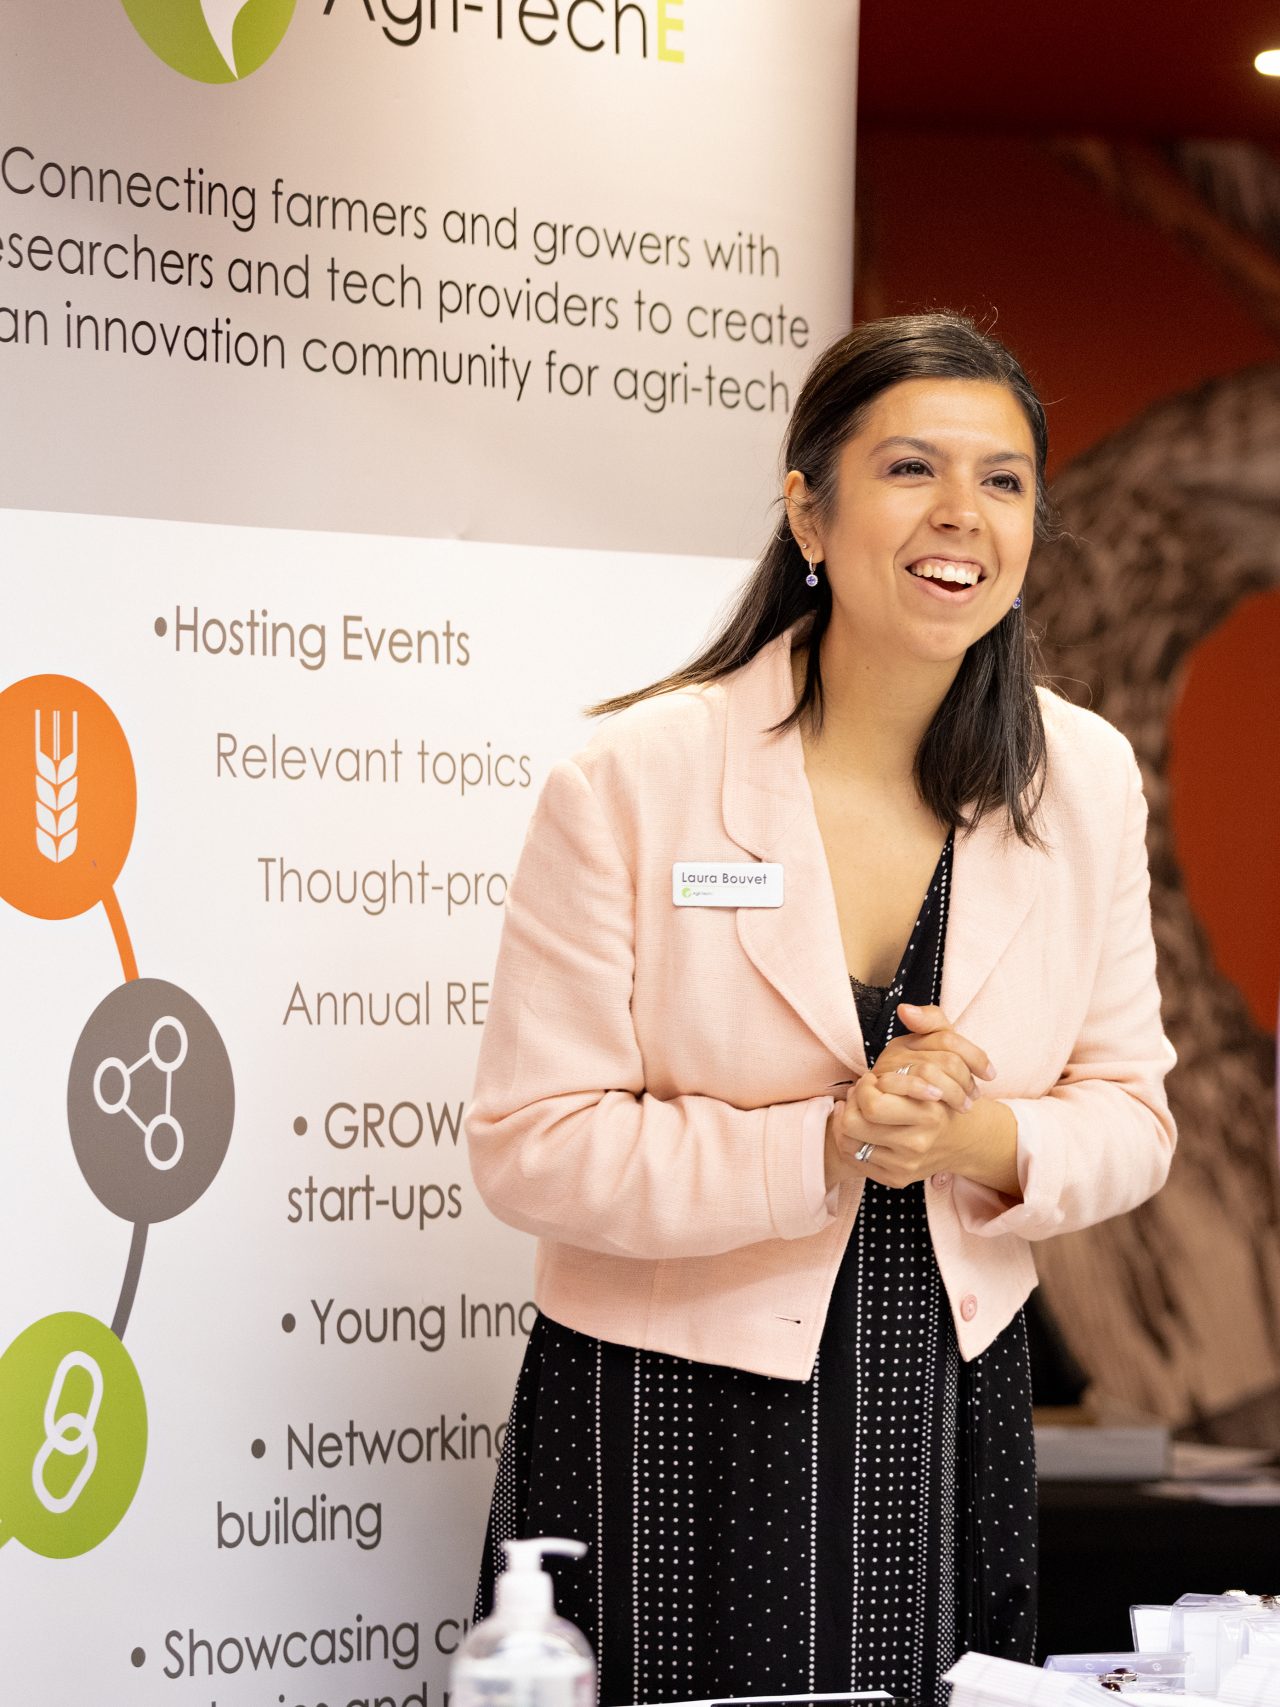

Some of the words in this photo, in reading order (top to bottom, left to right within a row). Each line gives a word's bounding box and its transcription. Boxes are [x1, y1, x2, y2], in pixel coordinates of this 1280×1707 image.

[323, 0, 685, 63] g-echE
[2, 146, 255, 232] Connecting
[272, 178, 427, 239] farmers
[443, 207, 517, 250] and
[533, 222, 690, 268] growers
[704, 232, 779, 277] with
[0, 233, 213, 289] searchers
[228, 254, 309, 299] and
[327, 257, 421, 310] tech
[439, 278, 618, 329] providers
[634, 290, 671, 334] to
[687, 305, 809, 349] create
[0, 307, 47, 345] an
[66, 301, 284, 369] innovation
[303, 338, 531, 402] community
[546, 350, 599, 396] for
[614, 362, 789, 413] agri-tech
[176, 606, 325, 670] Hosting
[344, 616, 469, 666] Events
[217, 733, 402, 782] Relevant
[418, 740, 530, 796] topics
[681, 872, 717, 884] Laura
[722, 873, 767, 885] Bouvet
[283, 981, 429, 1025] Annual
[325, 1102, 464, 1149] GROW
[288, 1175, 462, 1231] start-ups
[311, 1299, 445, 1353] Young
[217, 1493, 382, 1551] building
[163, 1613, 419, 1680] Showcasing
